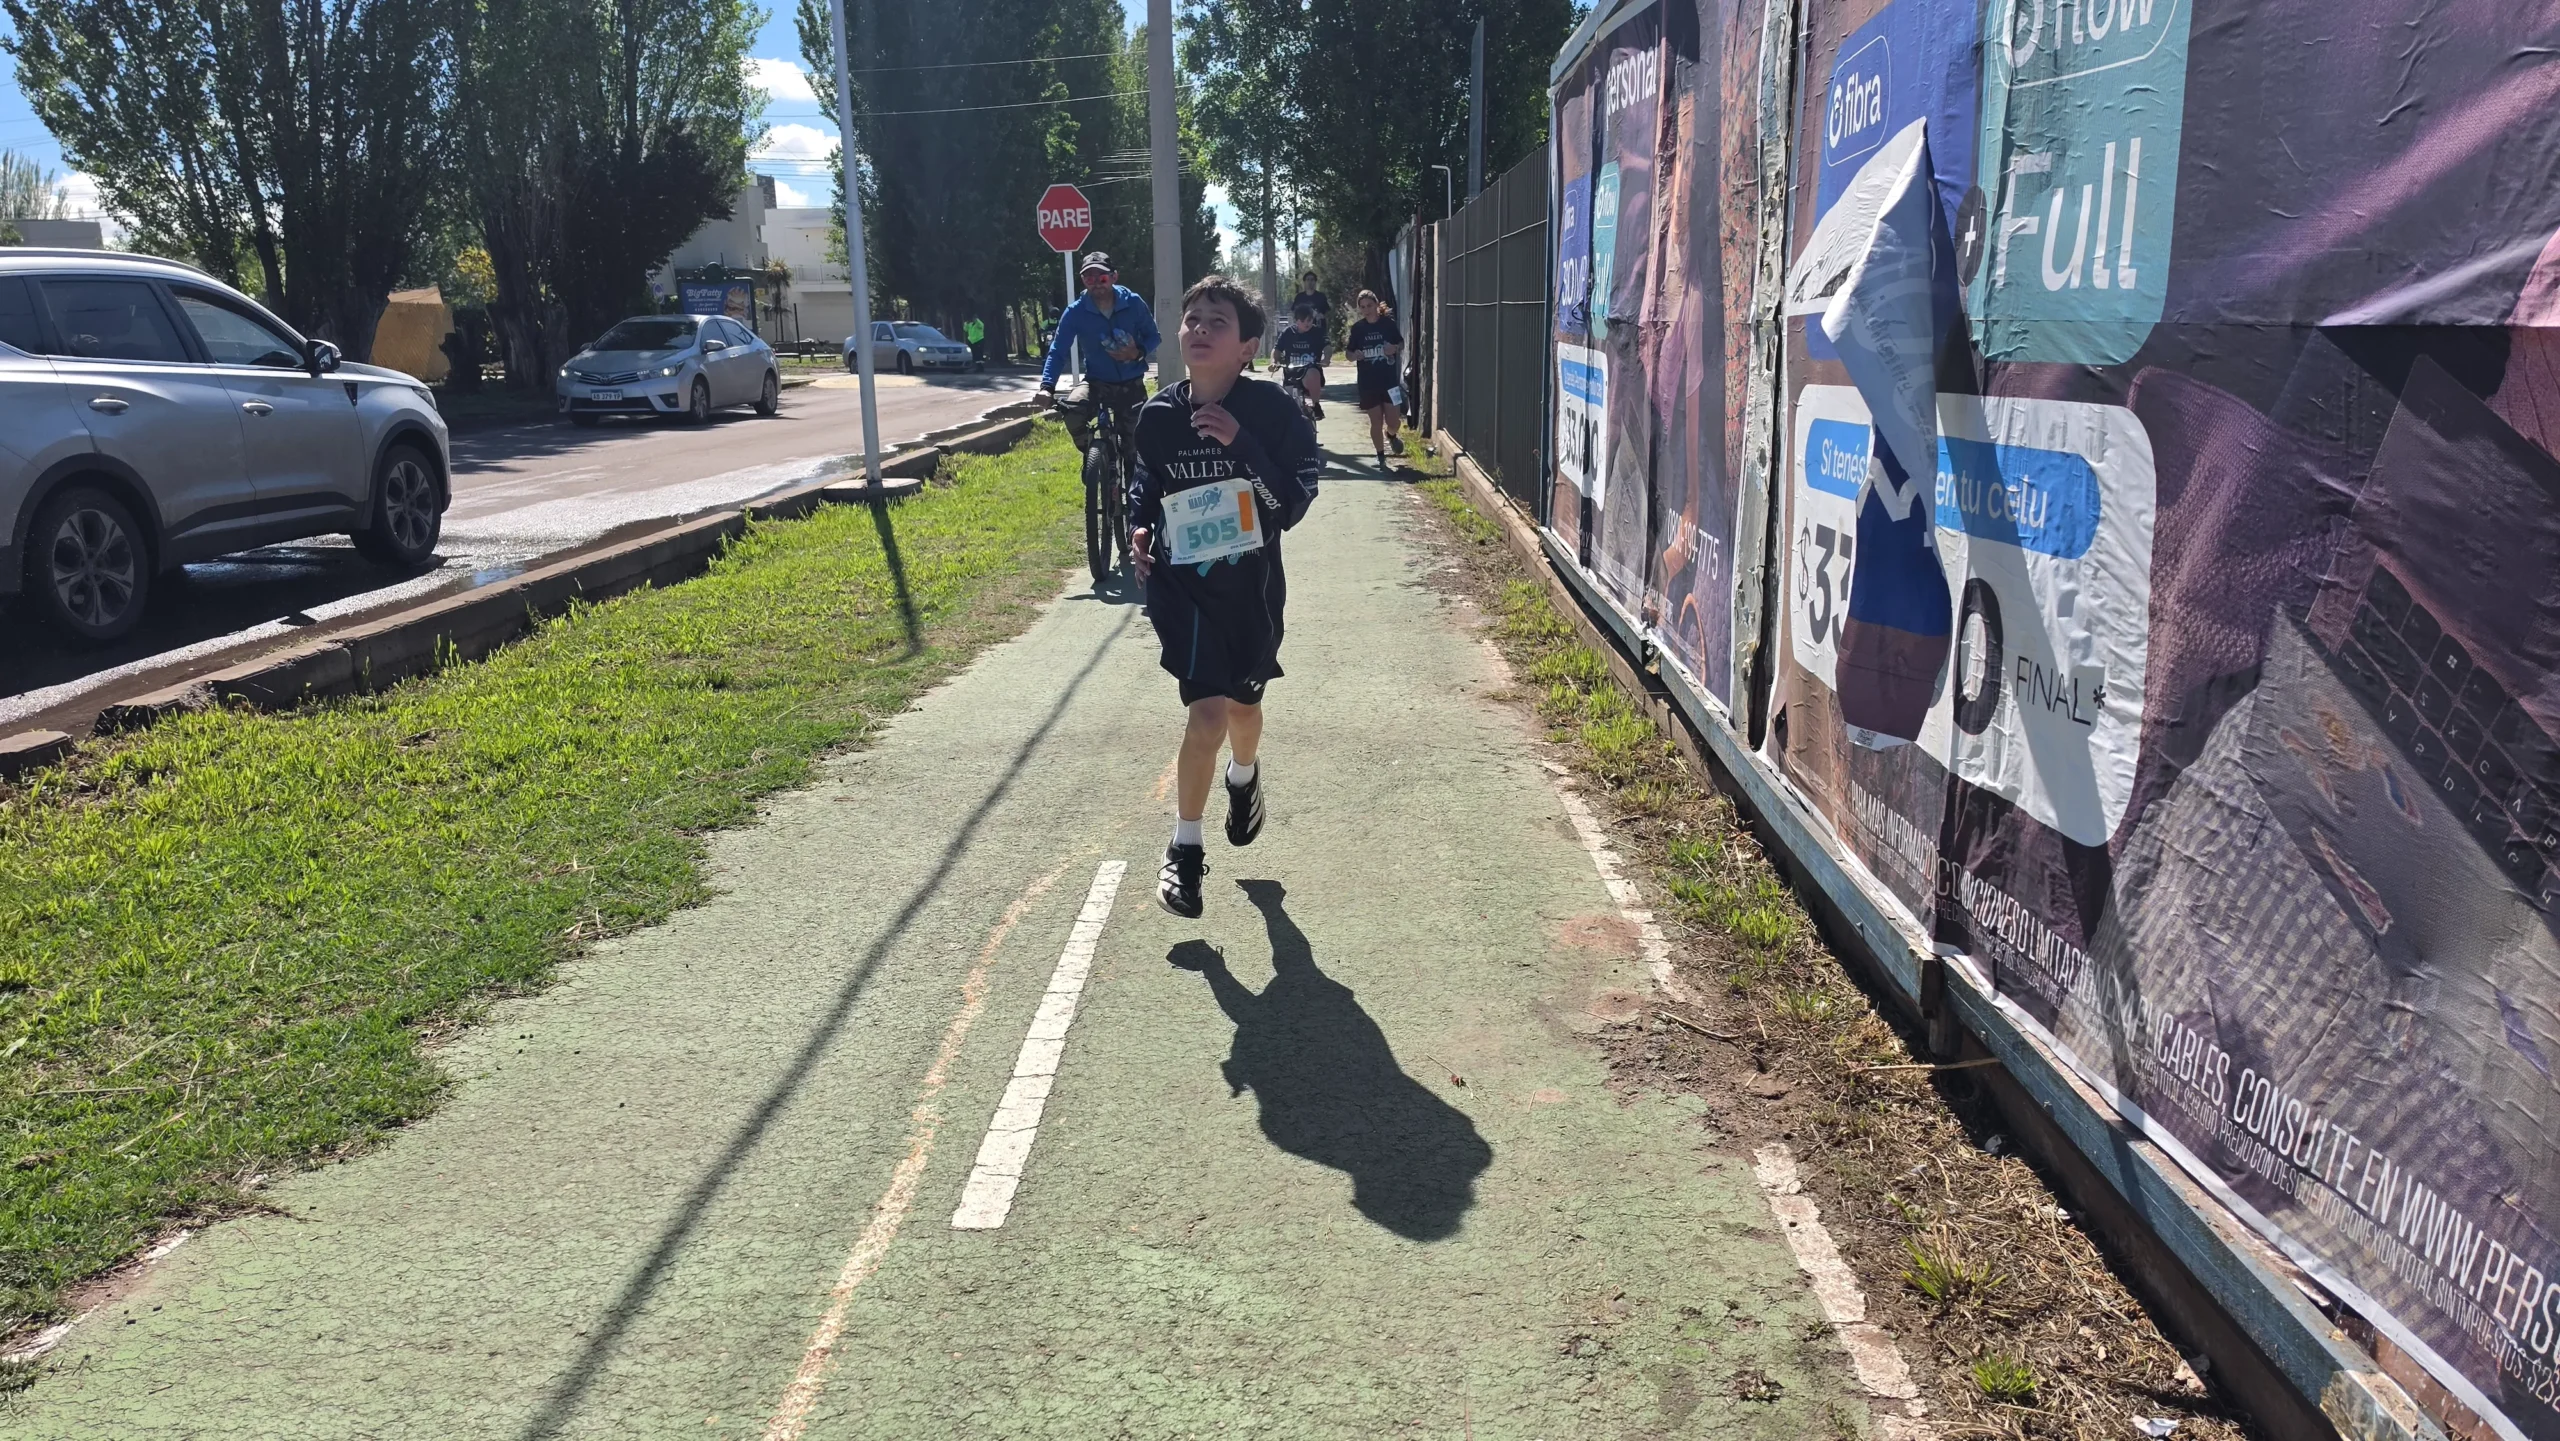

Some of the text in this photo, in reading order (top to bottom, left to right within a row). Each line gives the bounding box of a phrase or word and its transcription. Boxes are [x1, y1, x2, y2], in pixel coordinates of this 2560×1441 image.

[1843, 72, 1882, 138] fibra
[1039, 207, 1090, 230] PARE
[1995, 136, 2142, 291] Full
[1165, 460, 1236, 479] VALLEY
[1177, 447, 1222, 457] PALMARES
[1250, 476, 1281, 510] TORDOS
[1820, 438, 1831, 476] Si
[1831, 443, 1867, 486] tenés
[1935, 474, 1958, 509] en
[1960, 469, 1981, 515] tu
[1986, 474, 2048, 529] celu
[1186, 516, 1239, 549] 505
[1851, 779, 1868, 828] PARA
[1867, 794, 1886, 839] MÁS
[2017, 908, 2030, 953] O
[2233, 1067, 2362, 1196] CONSULTE
[2355, 1148, 2400, 1226] EN
[2398, 1174, 2560, 1366] WWW.PERS
[2218, 1115, 2253, 1162] PRECIO
[2249, 1142, 2276, 1180] CON
[2271, 1157, 2341, 1226] DESCUENTO
[2399, 1248, 2437, 1301] TOTAL
[2434, 1277, 2457, 1319] SIN
